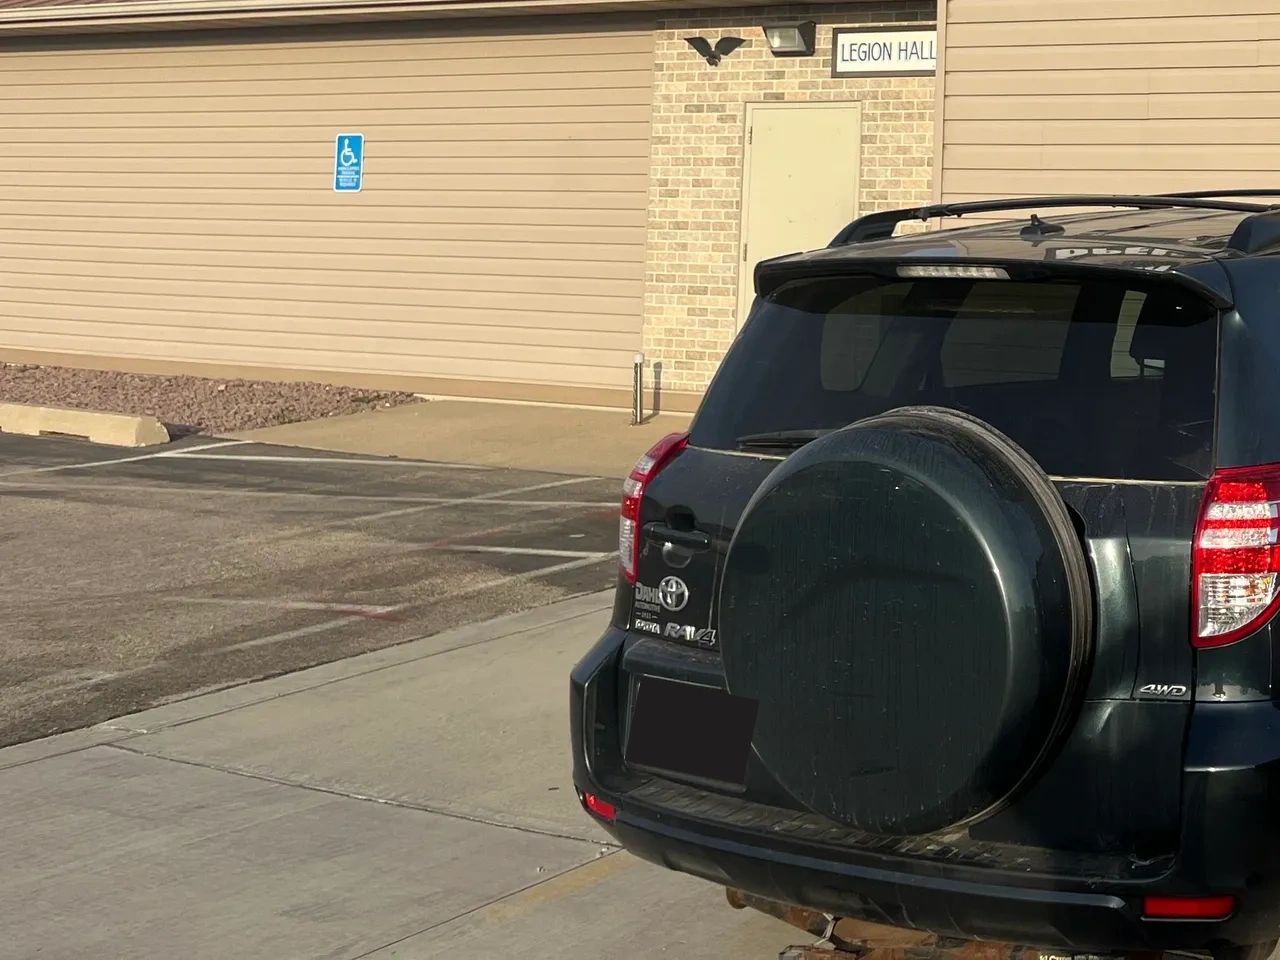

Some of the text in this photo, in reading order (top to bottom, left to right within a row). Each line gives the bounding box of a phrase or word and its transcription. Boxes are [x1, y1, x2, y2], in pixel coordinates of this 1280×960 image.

[841, 40, 936, 62] LEGION HALL
[635, 619, 660, 635] TOYOTA
[663, 622, 717, 647] RAV4
[1139, 684, 1187, 697] 4WD
